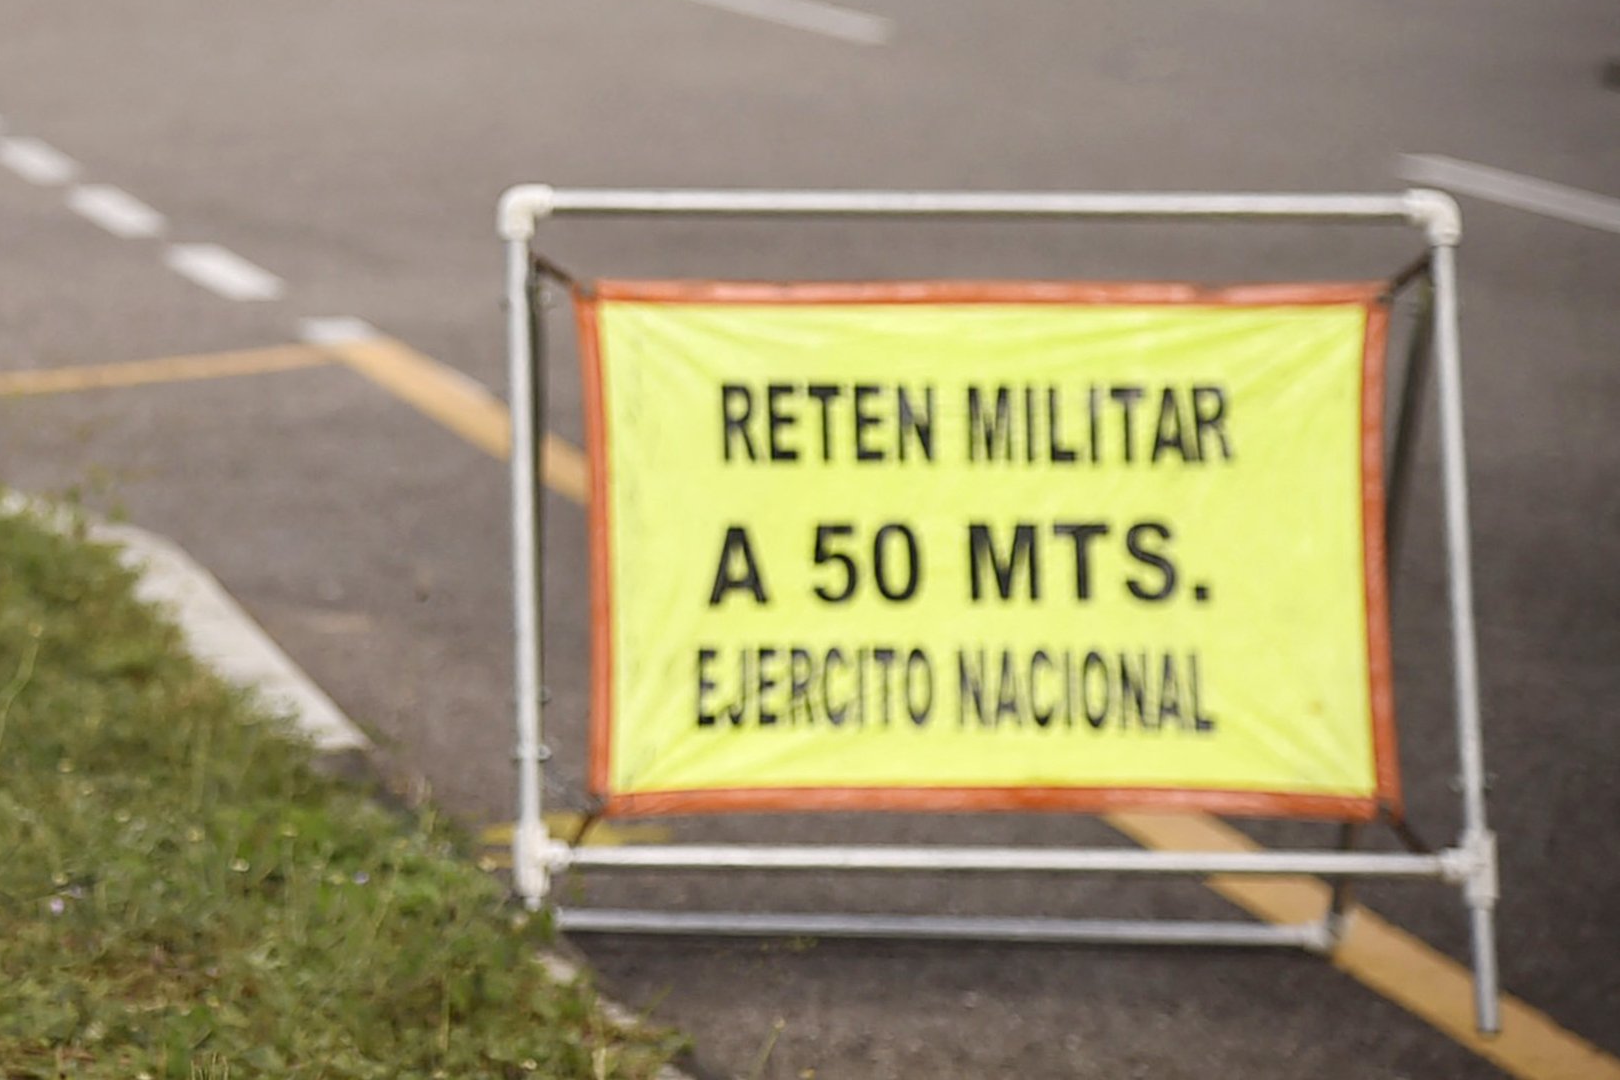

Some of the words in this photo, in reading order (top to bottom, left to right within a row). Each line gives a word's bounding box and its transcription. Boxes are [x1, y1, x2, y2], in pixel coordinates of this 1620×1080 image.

[720, 382, 934, 463] RETEN
[966, 384, 1231, 464] MILITAR
[708, 524, 769, 607] A
[813, 523, 921, 604] 50
[968, 521, 1209, 603] MTS.
[695, 647, 933, 728] EJERCITO
[958, 649, 1215, 732] NACIONAL
